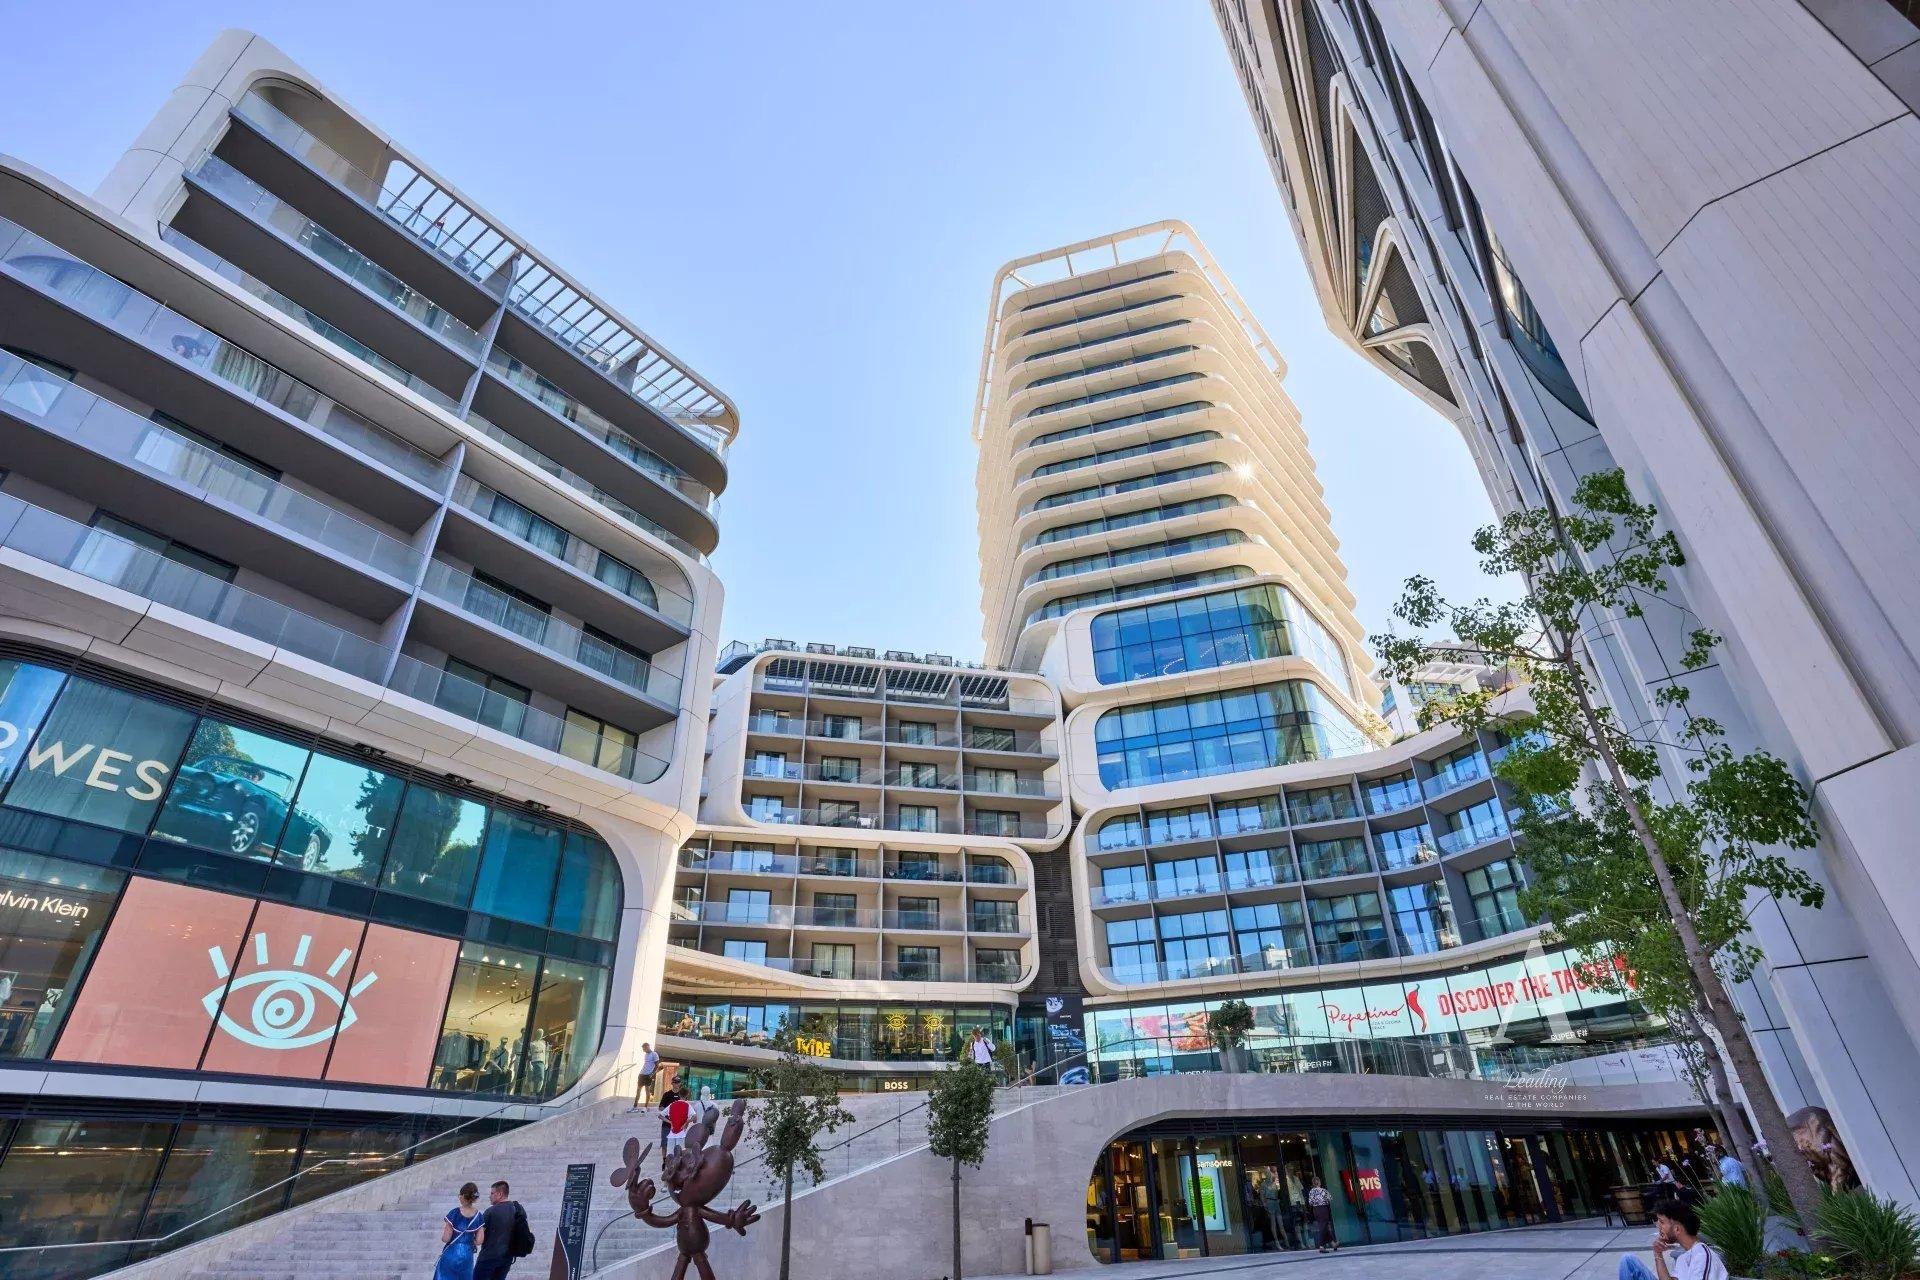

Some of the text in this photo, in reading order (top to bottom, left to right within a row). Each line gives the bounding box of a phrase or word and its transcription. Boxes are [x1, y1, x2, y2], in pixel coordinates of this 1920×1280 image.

[40, 896, 89, 919] Klein
[1437, 982, 1518, 1016] DISCOVER
[1519, 975, 1552, 1001] THE
[1317, 1004, 1405, 1033] Peperino
[884, 1081, 908, 1090] BOSS
